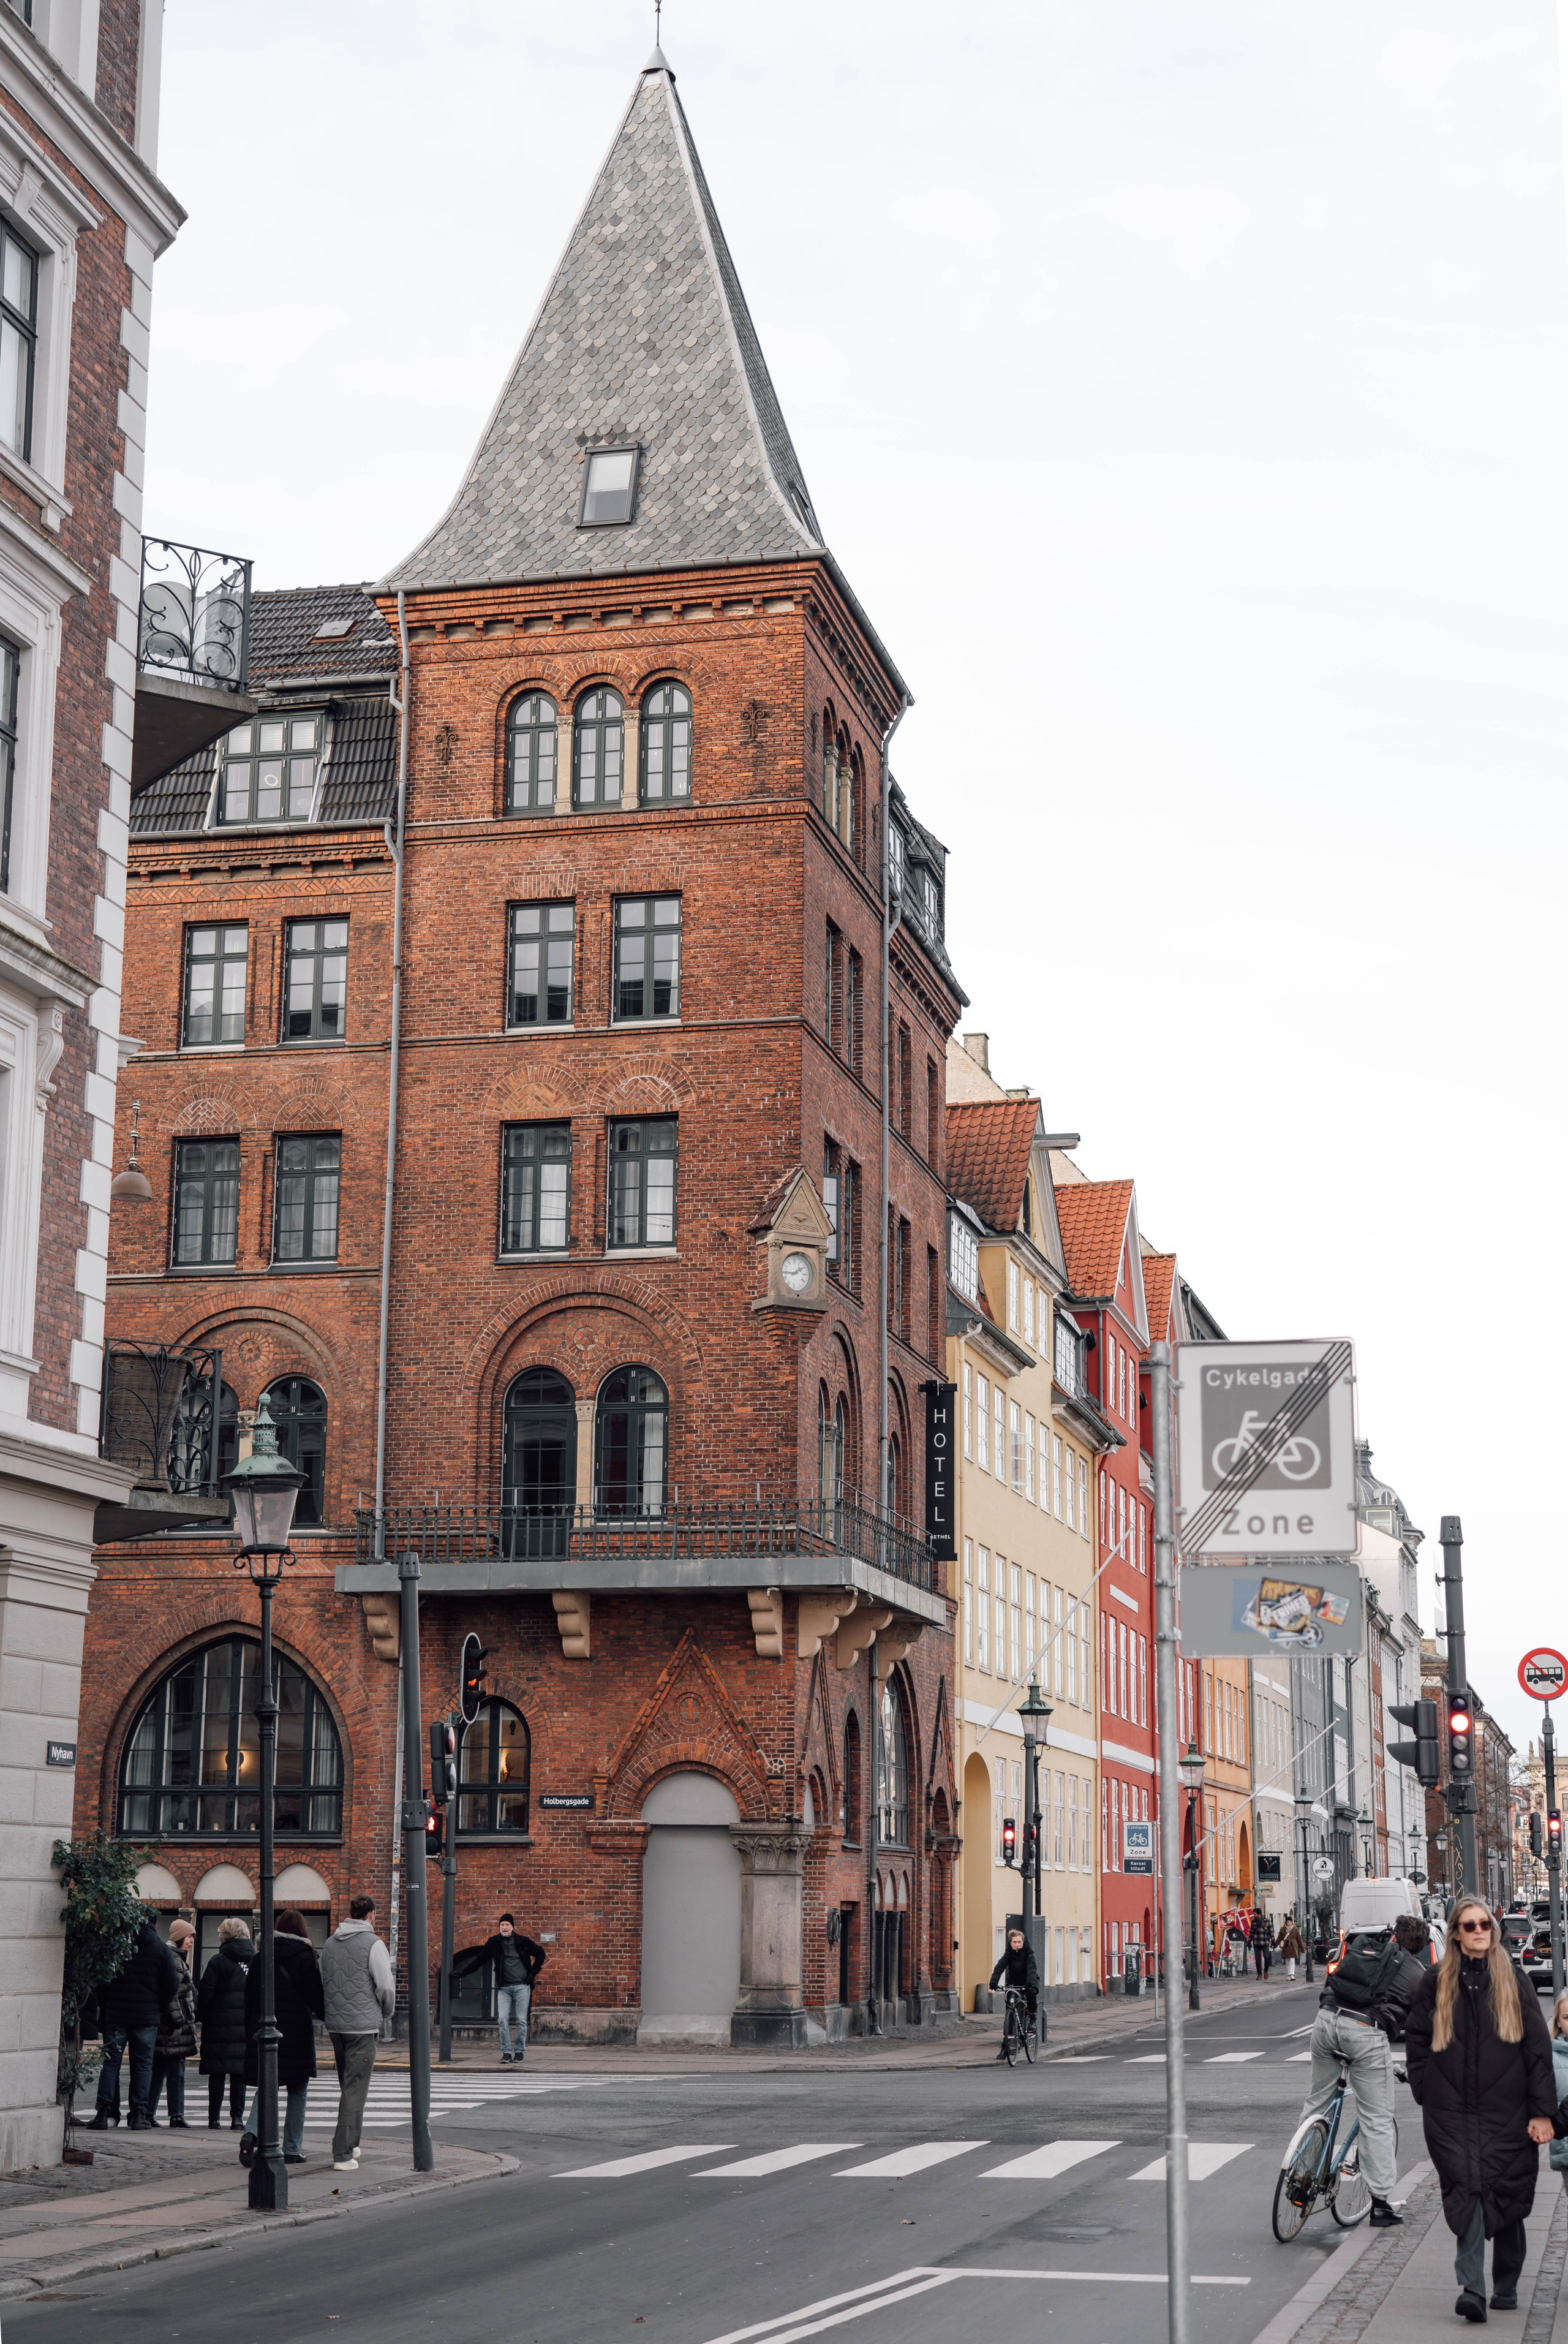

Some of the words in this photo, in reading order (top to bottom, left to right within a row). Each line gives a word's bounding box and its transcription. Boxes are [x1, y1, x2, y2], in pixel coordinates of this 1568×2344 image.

[1205, 1367, 1323, 1389] Cykelgade
[934, 1408, 946, 1522] HOTEL
[1221, 1509, 1314, 1535] Zone
[51, 1745, 73, 1761] Nyhavn
[543, 1798, 589, 1806] Holbergsgade
